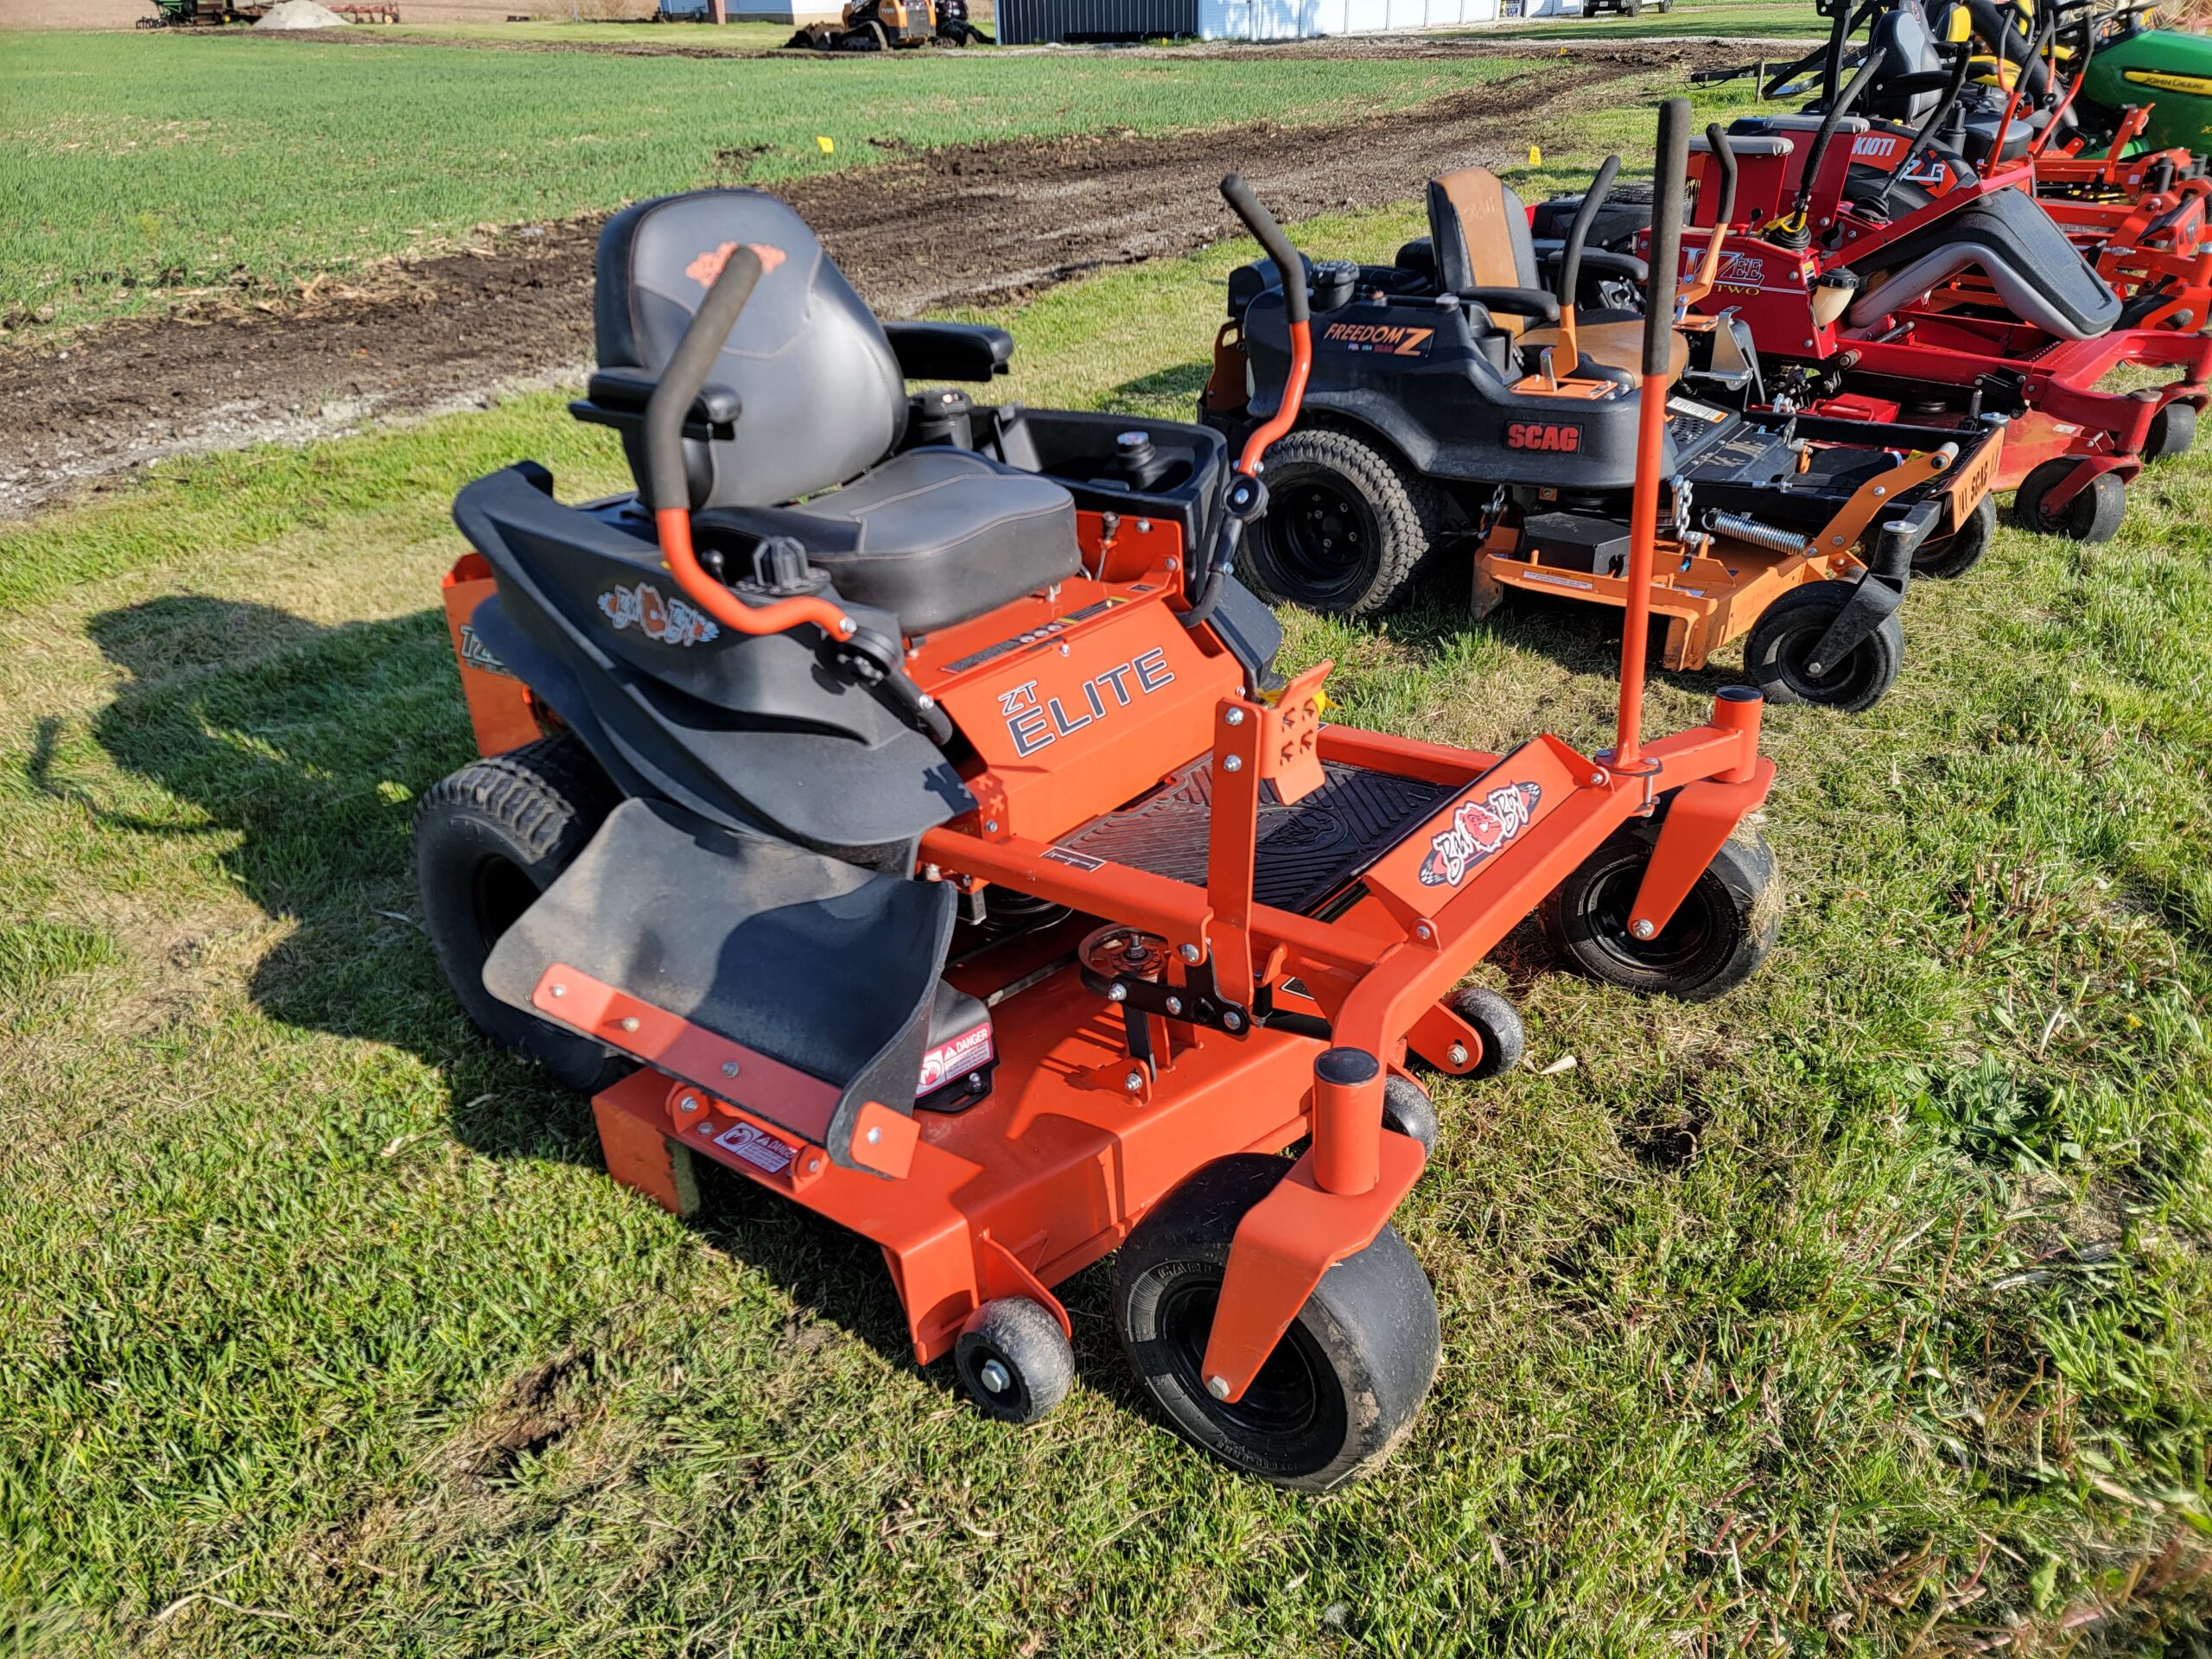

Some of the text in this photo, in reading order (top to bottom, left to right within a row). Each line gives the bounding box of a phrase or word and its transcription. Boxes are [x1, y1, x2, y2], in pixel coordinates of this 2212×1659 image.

[2143, 76, 2206, 89] JOHN DEERE
[1852, 137, 1896, 156] KIOTI
[1714, 283, 1760, 296] TWO
[1508, 423, 1579, 452] SCAG
[998, 679, 1038, 716] ZT
[1006, 646, 1176, 759] ELITE
[956, 1027, 988, 1053] DANGER
